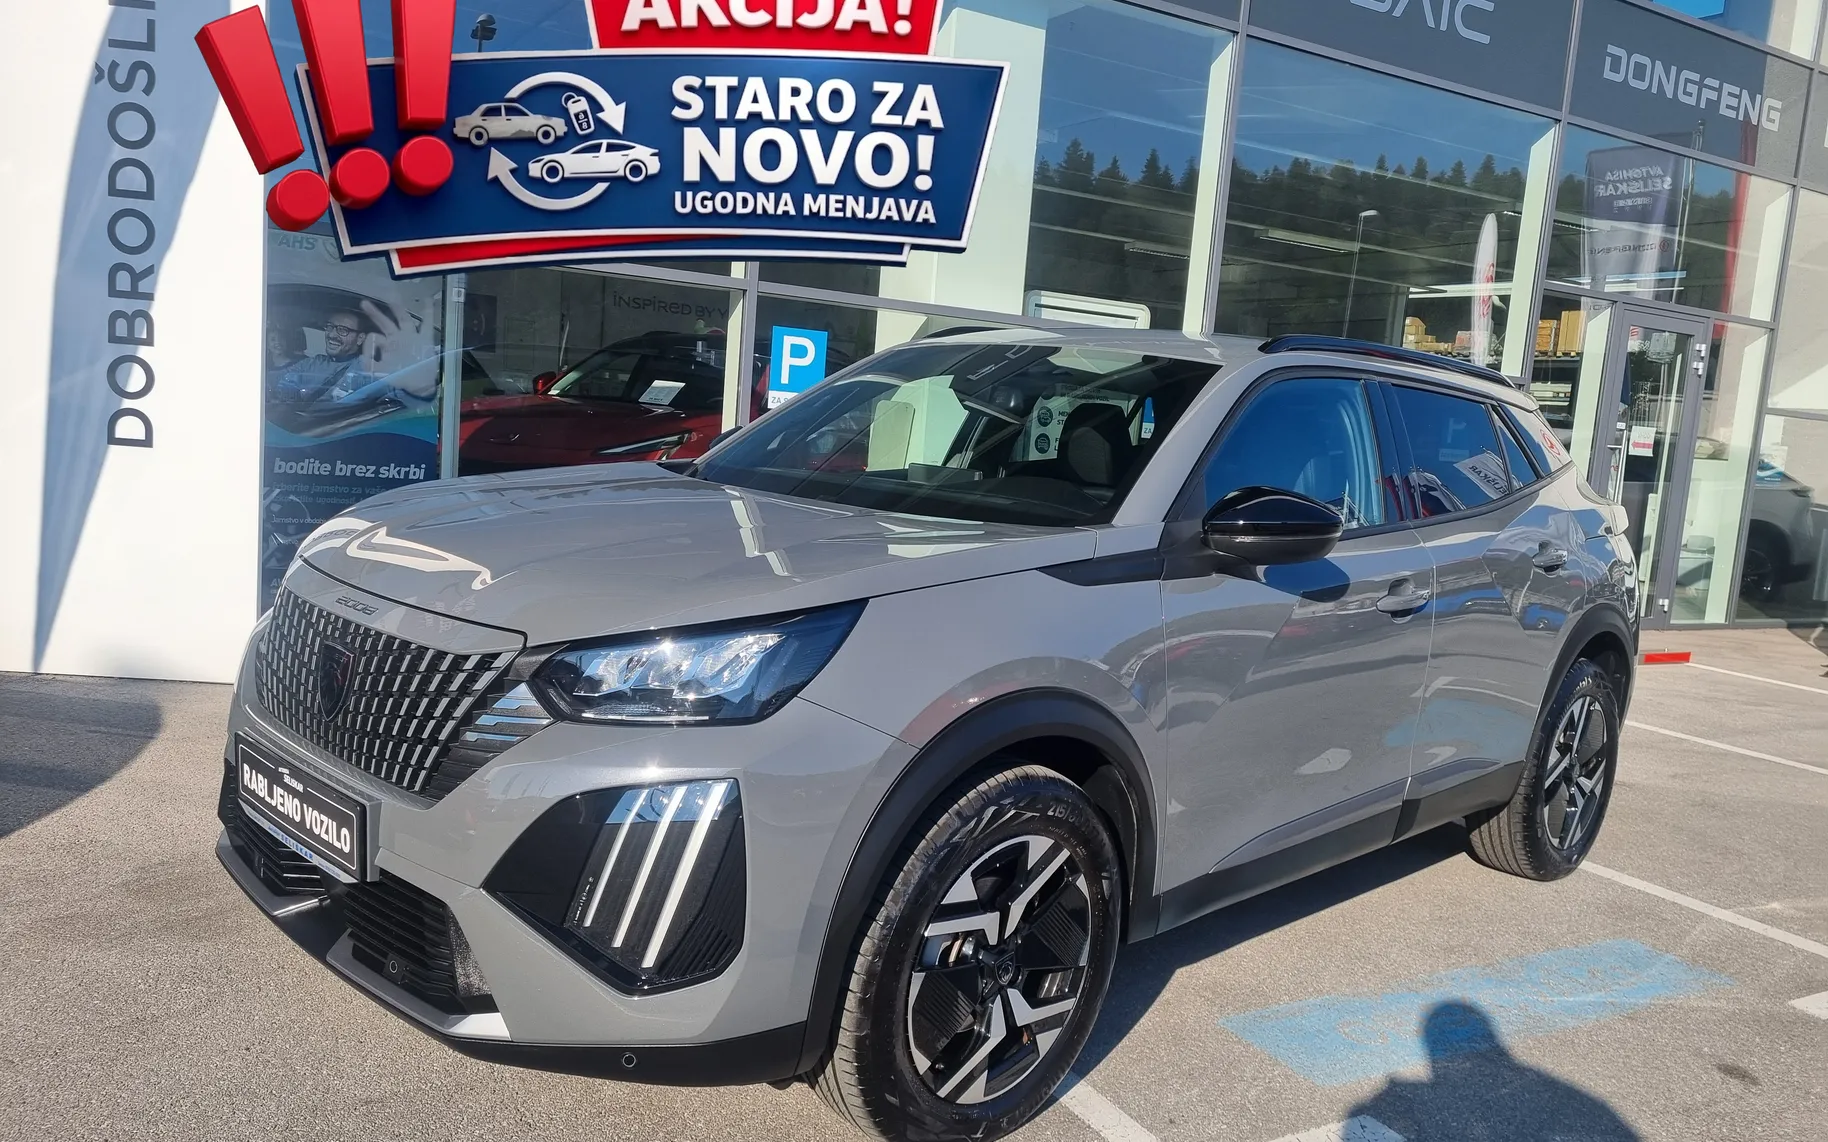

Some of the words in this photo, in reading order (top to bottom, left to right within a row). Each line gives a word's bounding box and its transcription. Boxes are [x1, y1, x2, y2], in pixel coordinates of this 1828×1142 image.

[1603, 44, 1782, 132] DONGFENG
[695, 306, 716, 318] BY
[781, 335, 816, 385] P
[273, 457, 331, 476] bodite
[335, 461, 376, 478] brez
[378, 463, 426, 480] skrbi
[311, 483, 349, 494] jamstvo
[335, 595, 379, 616] 2008
[243, 763, 301, 823] RABLJENO
[303, 803, 351, 854] VOZILO
